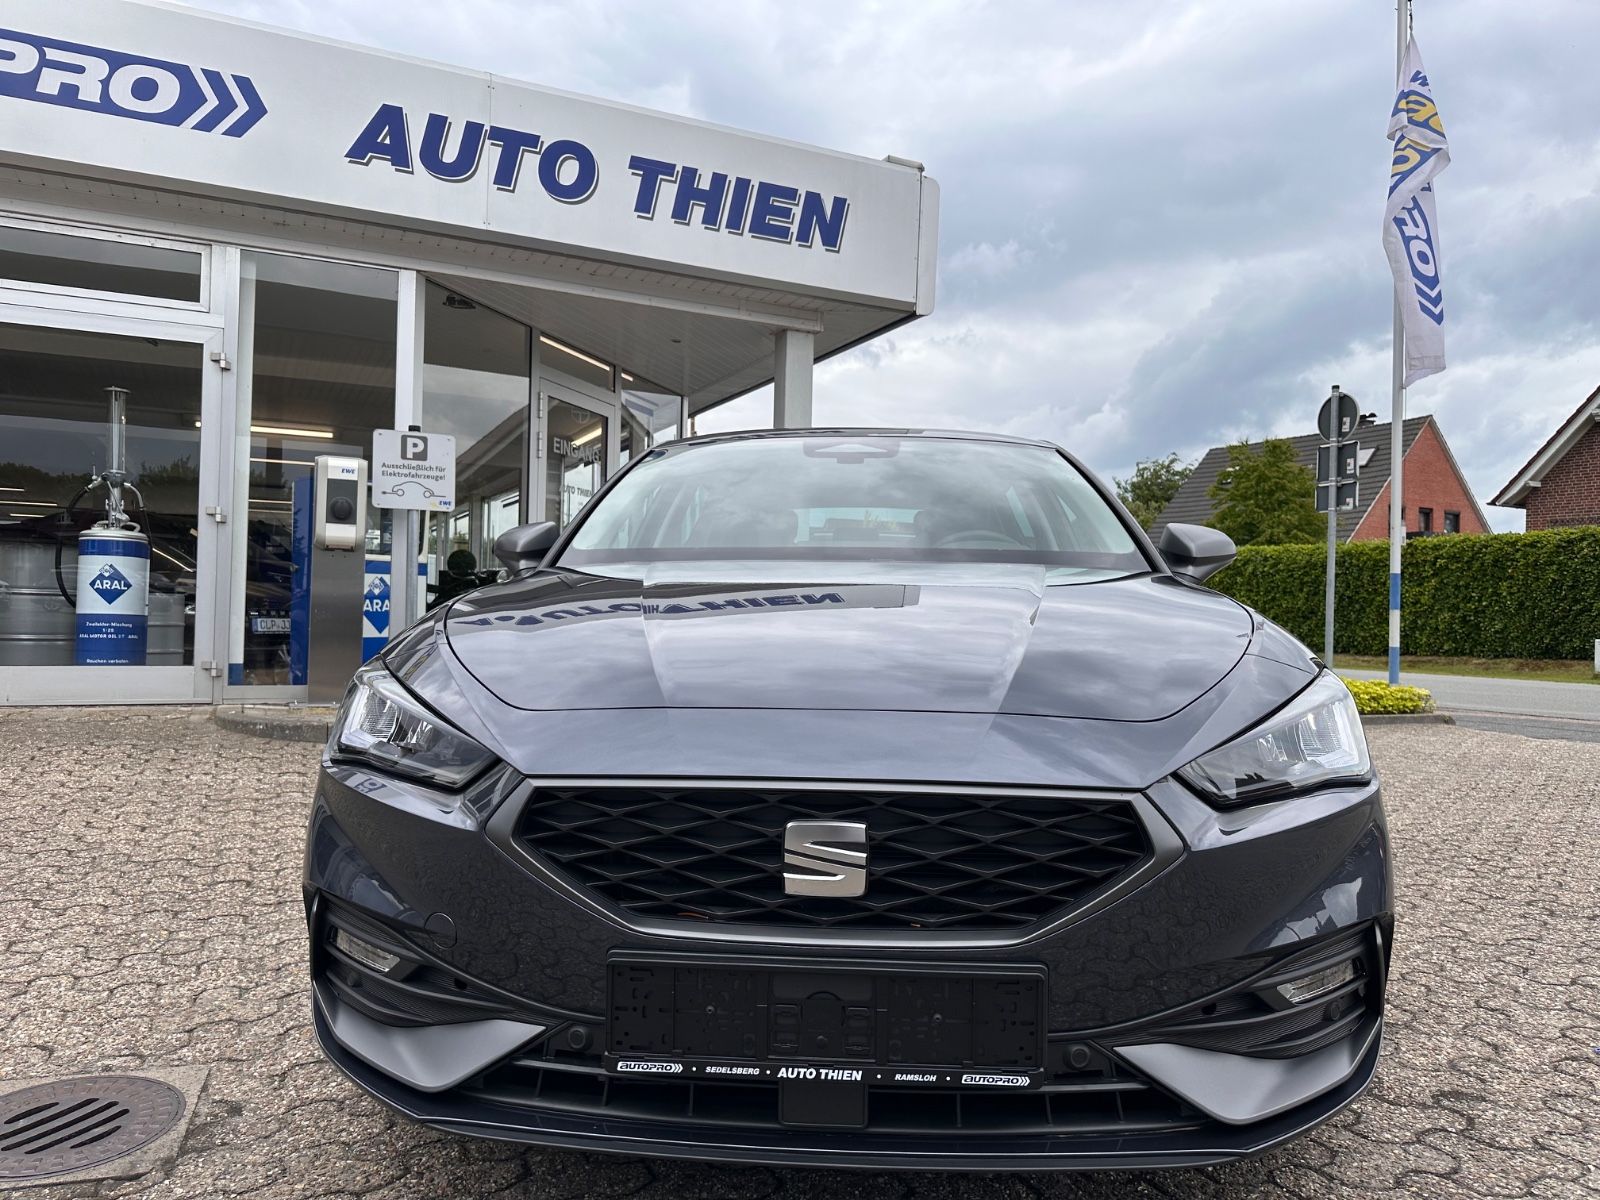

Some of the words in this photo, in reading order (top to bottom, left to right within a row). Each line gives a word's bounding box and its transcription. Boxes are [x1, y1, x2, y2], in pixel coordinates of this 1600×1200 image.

[343, 103, 601, 205] AUTO
[628, 155, 850, 253] THIEN
[553, 437, 601, 464] EINGANG
[381, 462, 434, 472] Ausschließlich
[435, 465, 446, 473] für
[94, 580, 127, 590] ARAL
[705, 1065, 760, 1075] SEDELSBERG
[777, 1067, 817, 1080] AUTO
[819, 1069, 863, 1081] THIEN
[894, 1073, 937, 1082] RAMSLOH
